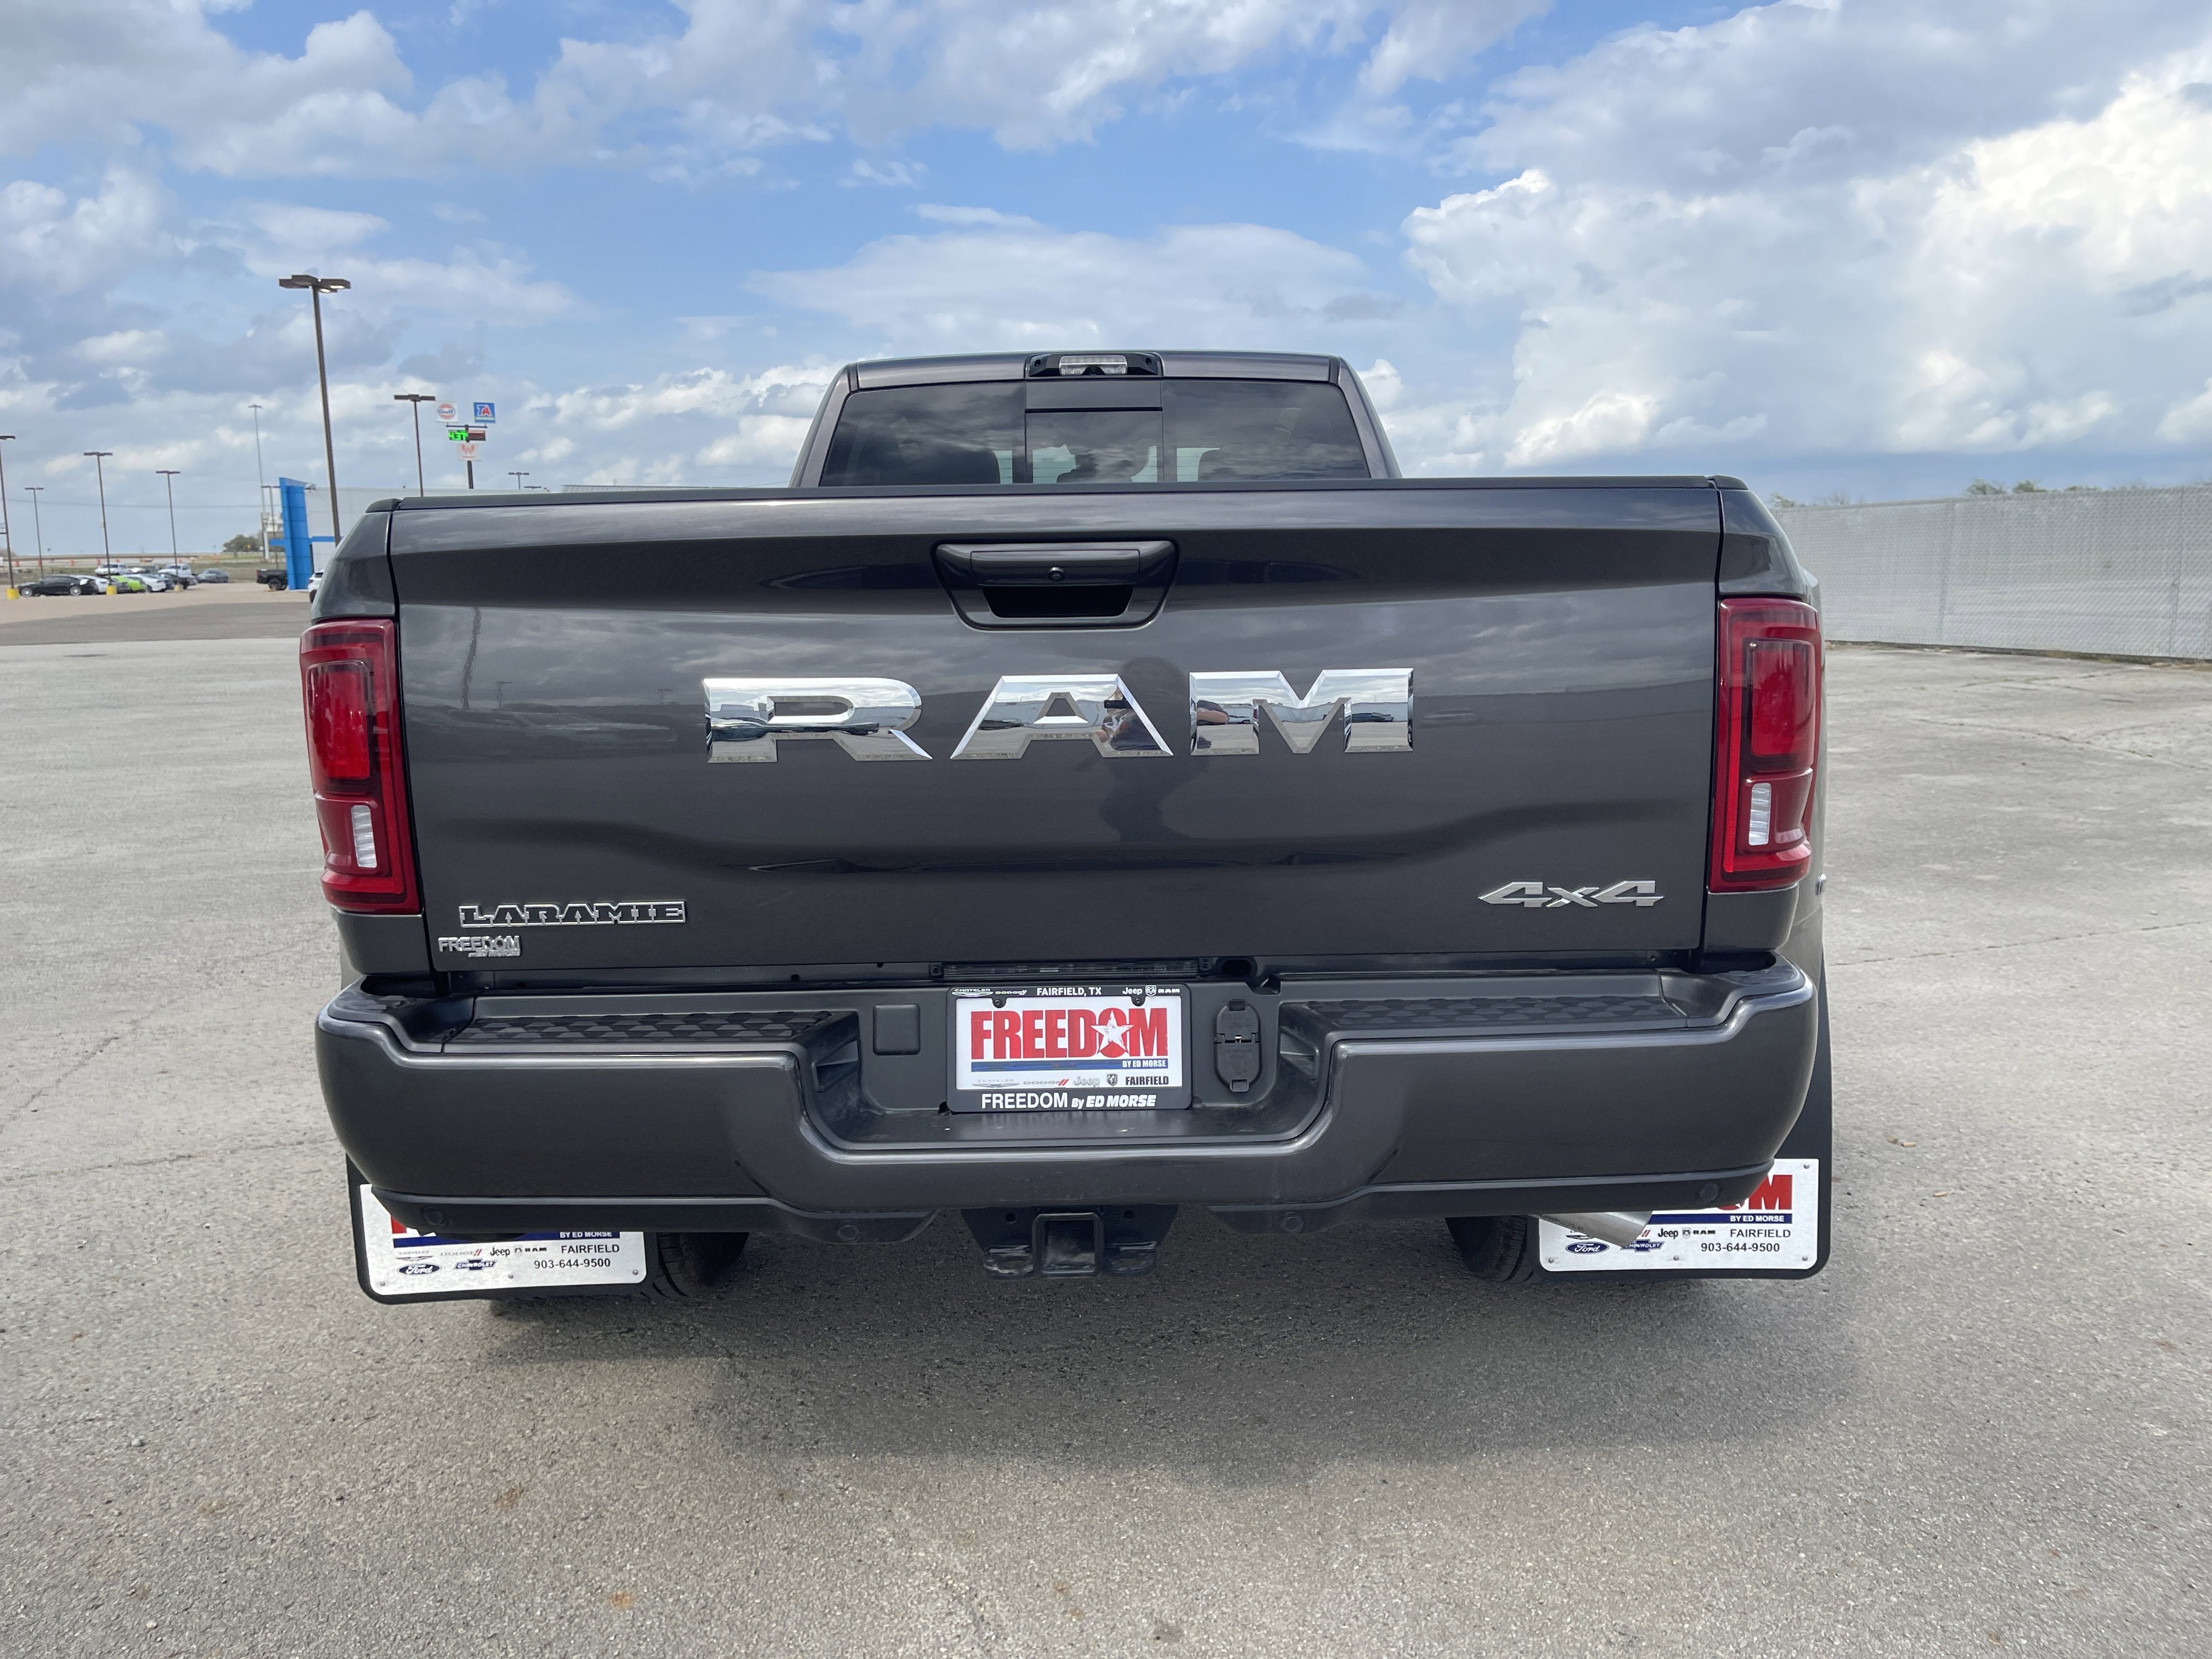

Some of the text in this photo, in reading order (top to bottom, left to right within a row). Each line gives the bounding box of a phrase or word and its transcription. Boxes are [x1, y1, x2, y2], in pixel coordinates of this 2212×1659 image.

[476, 404, 492, 416] TA
[702, 667, 1414, 764] RAM
[459, 900, 687, 928] LARAMIE
[438, 935, 521, 952] FREEDOM
[1036, 986, 1102, 997] FAIRFIELD, TX
[1122, 987, 1143, 996] Jeep
[970, 1007, 1169, 1060] FREEDOM
[1142, 1059, 1166, 1068] MORSE
[1073, 1076, 1100, 1087] Jeep
[1125, 1076, 1169, 1086] FAIRFIELD
[981, 1092, 1157, 1109] FREEDOM By ED MORSE
[1658, 1228, 1678, 1239] Jeep
[1730, 1229, 1791, 1238] FAIRFIELD
[490, 1247, 510, 1257] Jeep
[561, 1244, 620, 1254] FAIRFIELD
[1574, 1243, 1600, 1253] Ford
[1701, 1243, 1780, 1252] 903-644-9500
[534, 1258, 611, 1269] 903-644-9500
[405, 1265, 433, 1274] Ford
